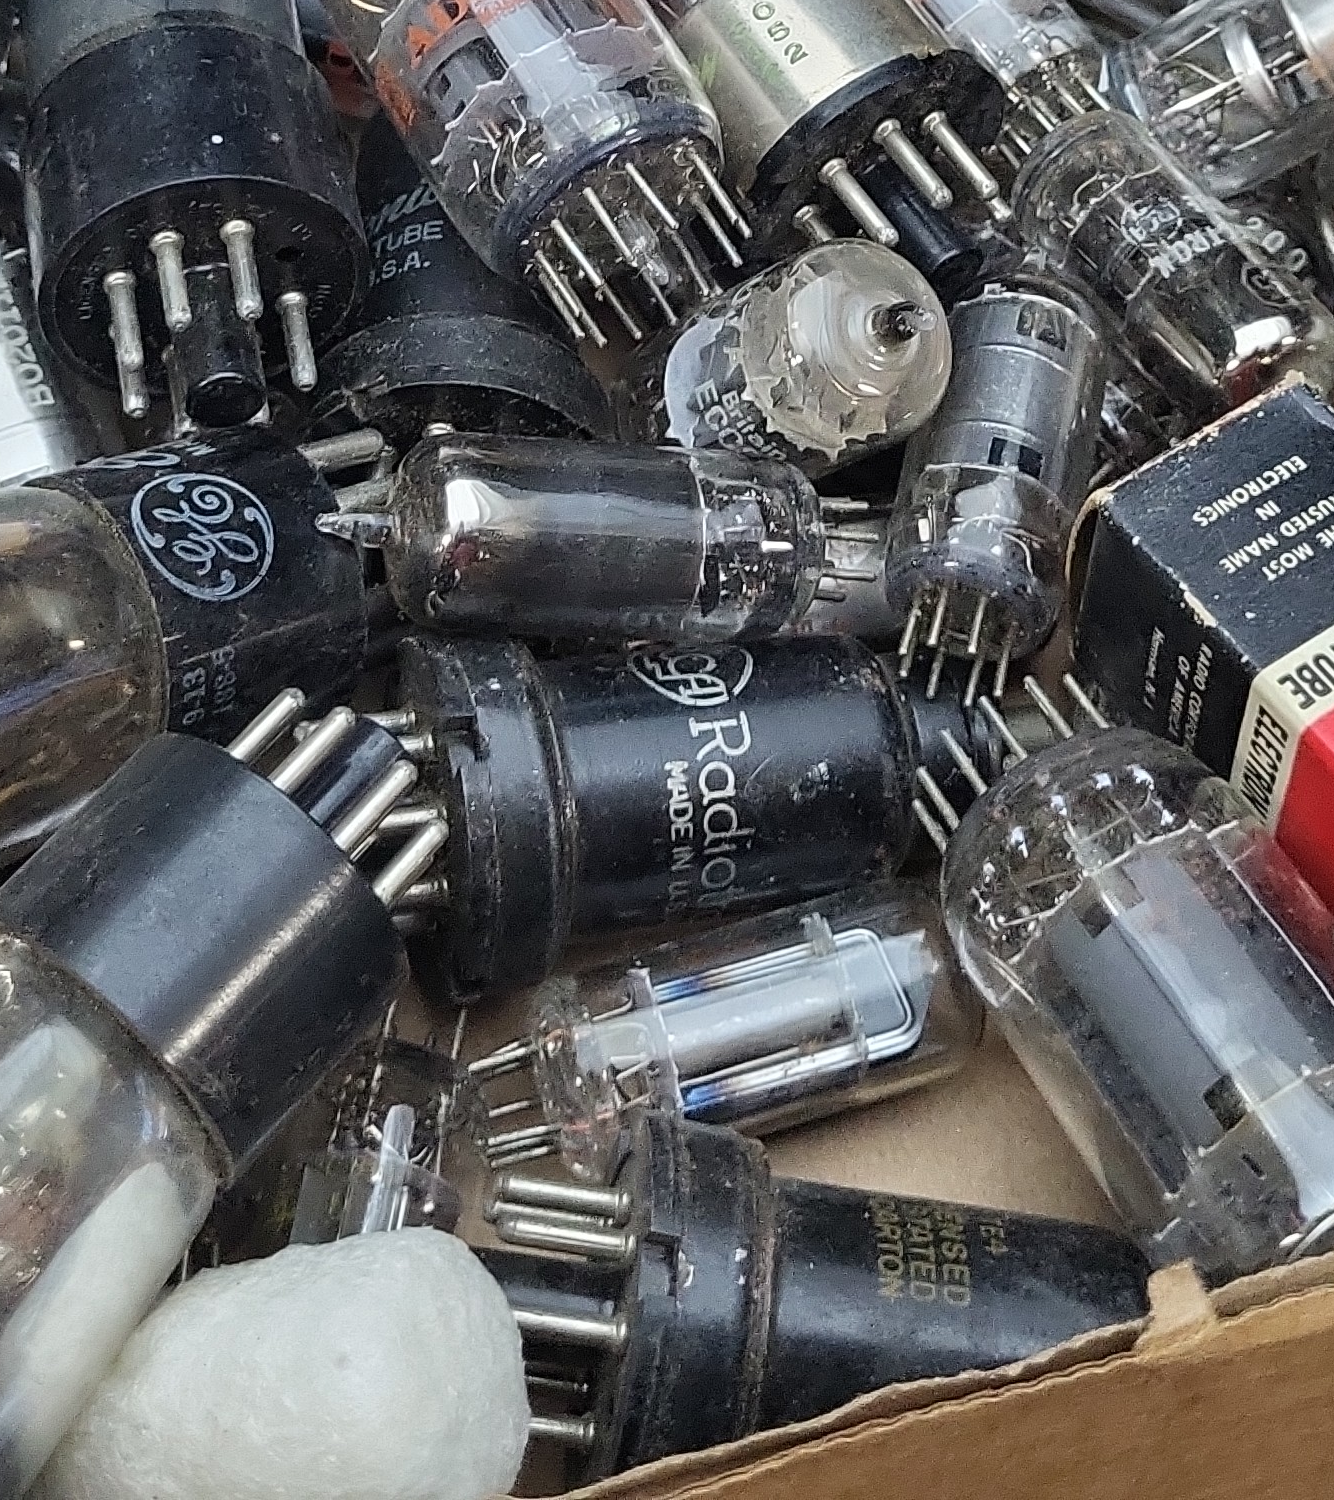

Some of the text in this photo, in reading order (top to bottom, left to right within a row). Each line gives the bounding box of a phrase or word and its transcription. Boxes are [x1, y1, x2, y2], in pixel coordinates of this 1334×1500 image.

[1192, 455, 1308, 527] ELECTRONICS
[1254, 499, 1282, 521] IN
[1218, 532, 1280, 574] NAME
[1261, 542, 1315, 581] MOST
[1192, 642, 1214, 692] RADIO
[664, 760, 695, 843] MADE
[671, 846, 695, 873] IN
